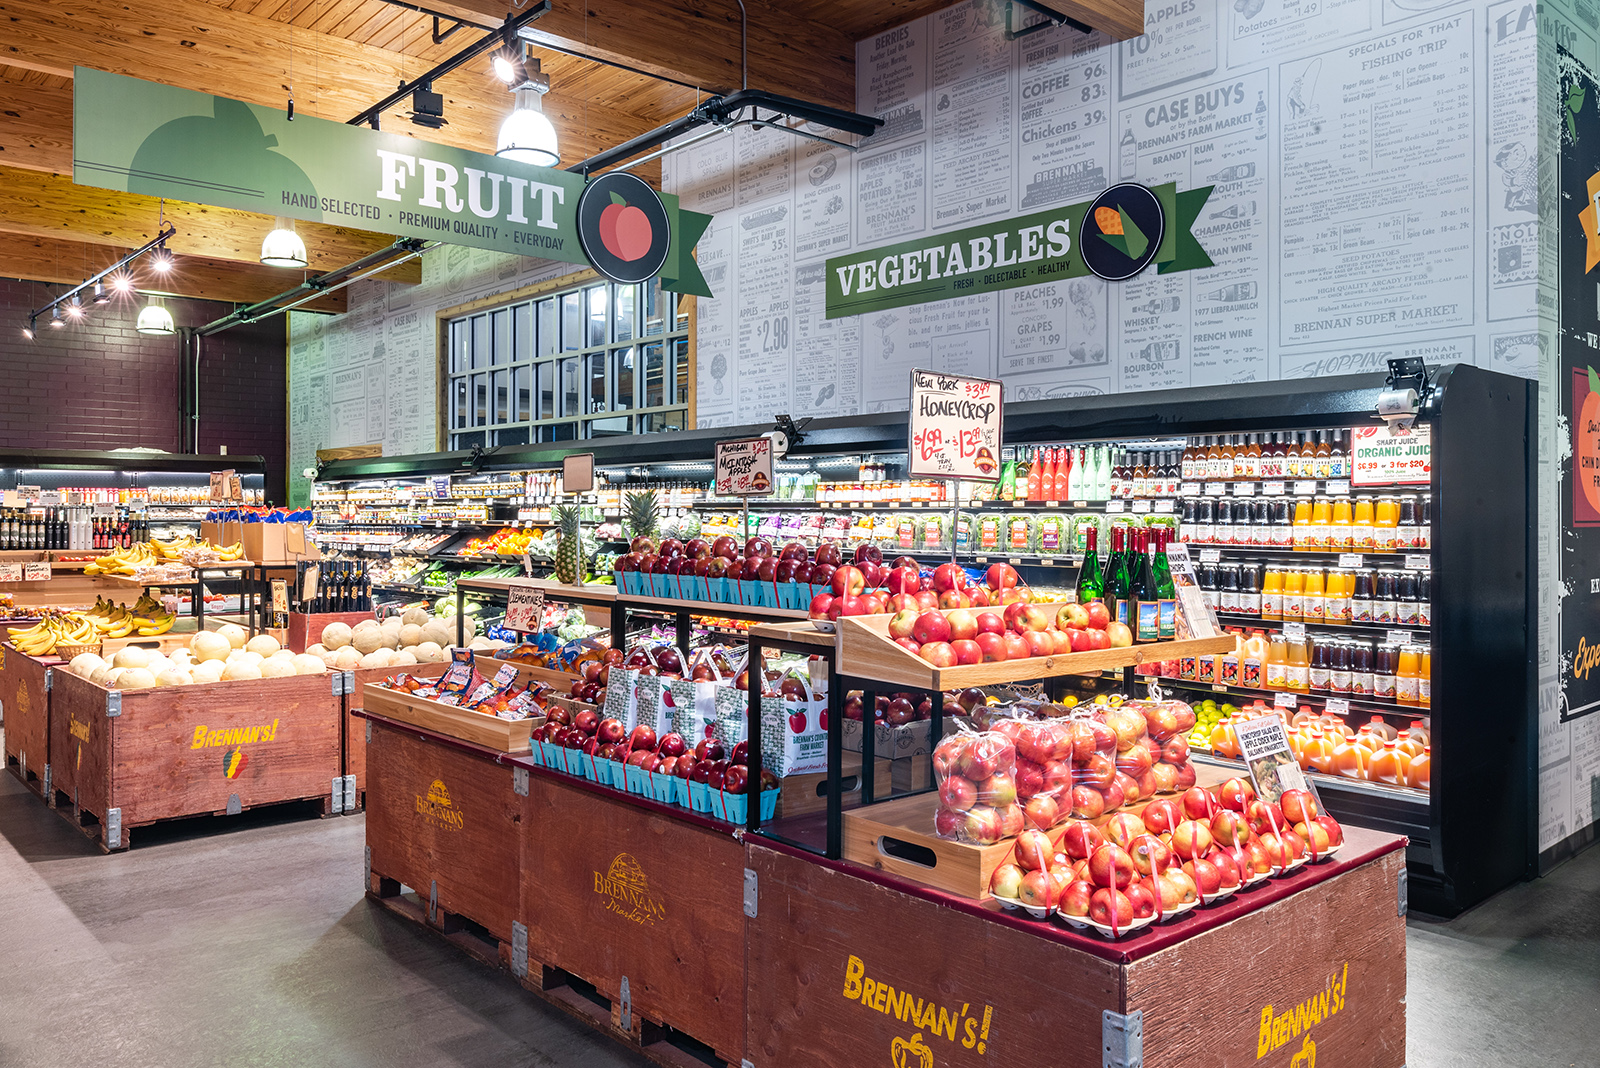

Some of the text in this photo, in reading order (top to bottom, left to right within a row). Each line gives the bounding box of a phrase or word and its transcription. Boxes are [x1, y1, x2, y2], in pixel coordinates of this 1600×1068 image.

[1146, 0, 1196, 27] APPLES
[1238, 17, 1278, 35] Potatoes
[875, 26, 909, 51] BERRIES
[1348, 18, 1461, 58] SPECIALS FOR THAT
[1026, 44, 1059, 63] FRESH FISH
[1072, 42, 1100, 60] POULTRY
[1361, 39, 1448, 71] FISHING TRIP
[1406, 61, 1438, 75] Can Opener
[1022, 74, 1070, 100] COFFEE
[1342, 77, 1375, 91] Paper Plates
[1406, 73, 1446, 88] Sandwich Bags
[1361, 91, 1377, 100] Paper
[1144, 82, 1245, 128] CASE BUYS
[1178, 121, 1187, 130] by
[1187, 117, 1197, 126] the
[1198, 113, 1217, 123] Bottle
[1022, 121, 1077, 143] Chickens
[1137, 113, 1253, 151] BRENNAN'S FARM MARKET
[860, 145, 922, 170] CHRISTMAS TREES
[1152, 149, 1187, 165] BRANDY
[1194, 143, 1215, 155] RUM
[1035, 158, 1095, 183] BRENNAN'S
[376, 149, 564, 230] FRUIT
[698, 183, 732, 201] BRENNAN'S
[859, 178, 883, 192] APPLES
[859, 186, 892, 202] POTATOES
[866, 205, 916, 225] BRENNAN'S
[936, 194, 1007, 220] Brennan's Super Market
[281, 190, 564, 250] HAND SELECTED PREMIUM QUALITY EVERYDAY
[1194, 218, 1252, 237] CHAMPAGNE
[1407, 216, 1420, 224] Peas
[1407, 228, 1435, 240] Spice Cake
[1230, 242, 1253, 254] WINE
[1342, 249, 1400, 264] SEED POTATOES
[836, 219, 1071, 296] VEGETABLES
[953, 260, 1071, 290] FRESH DELECTABLE HEALTHY
[1317, 273, 1428, 295] HIGH QUALITY ARCADY FEEDS
[908, 296, 976, 315] Shop Brennan's Now for
[1014, 285, 1064, 310] PEACHES $1.99
[1317, 293, 1427, 313] Highest Market Prices Paid For Eggs
[740, 306, 759, 318] APPLES
[769, 300, 789, 313] APPLES
[924, 314, 940, 323] Fresh
[941, 311, 956, 321] Fruit
[957, 309, 966, 318] for
[967, 308, 980, 318] your
[1194, 302, 1259, 316] 1977 LIEBFRAUMILCH
[1293, 317, 1353, 333] BRENNAN
[1356, 311, 1397, 326] SUPER
[1401, 303, 1459, 321] MARKET
[1021, 314, 1048, 324] CONCORD
[1124, 316, 1160, 328] WHISKEY
[756, 316, 789, 353] $2.98
[920, 326, 931, 335] and
[934, 324, 943, 333] for
[1017, 320, 1061, 346] GRAPES $1.99
[1193, 328, 1253, 343] FRENCH WINE
[1404, 345, 1457, 357] BRENNAN
[1425, 352, 1463, 362] MARKET
[1009, 356, 1036, 369] SERVE THE
[1124, 362, 1165, 374] BOURBON
[1301, 351, 1394, 378] SHOPPING
[936, 376, 960, 391] YORK
[920, 394, 996, 424] HONEYCRISP
[1376, 437, 1418, 446] SMART JUICE
[1357, 446, 1403, 458] ORGANIC
[1357, 462, 1378, 471] $6.99
[1389, 461, 1395, 469] 3
[1409, 460, 1424, 468] $20
[190, 718, 280, 751] BRENNAN'S!
[842, 953, 995, 1056] BRENNAN'S!
[1256, 960, 1350, 1060] BRENNAN'S!
